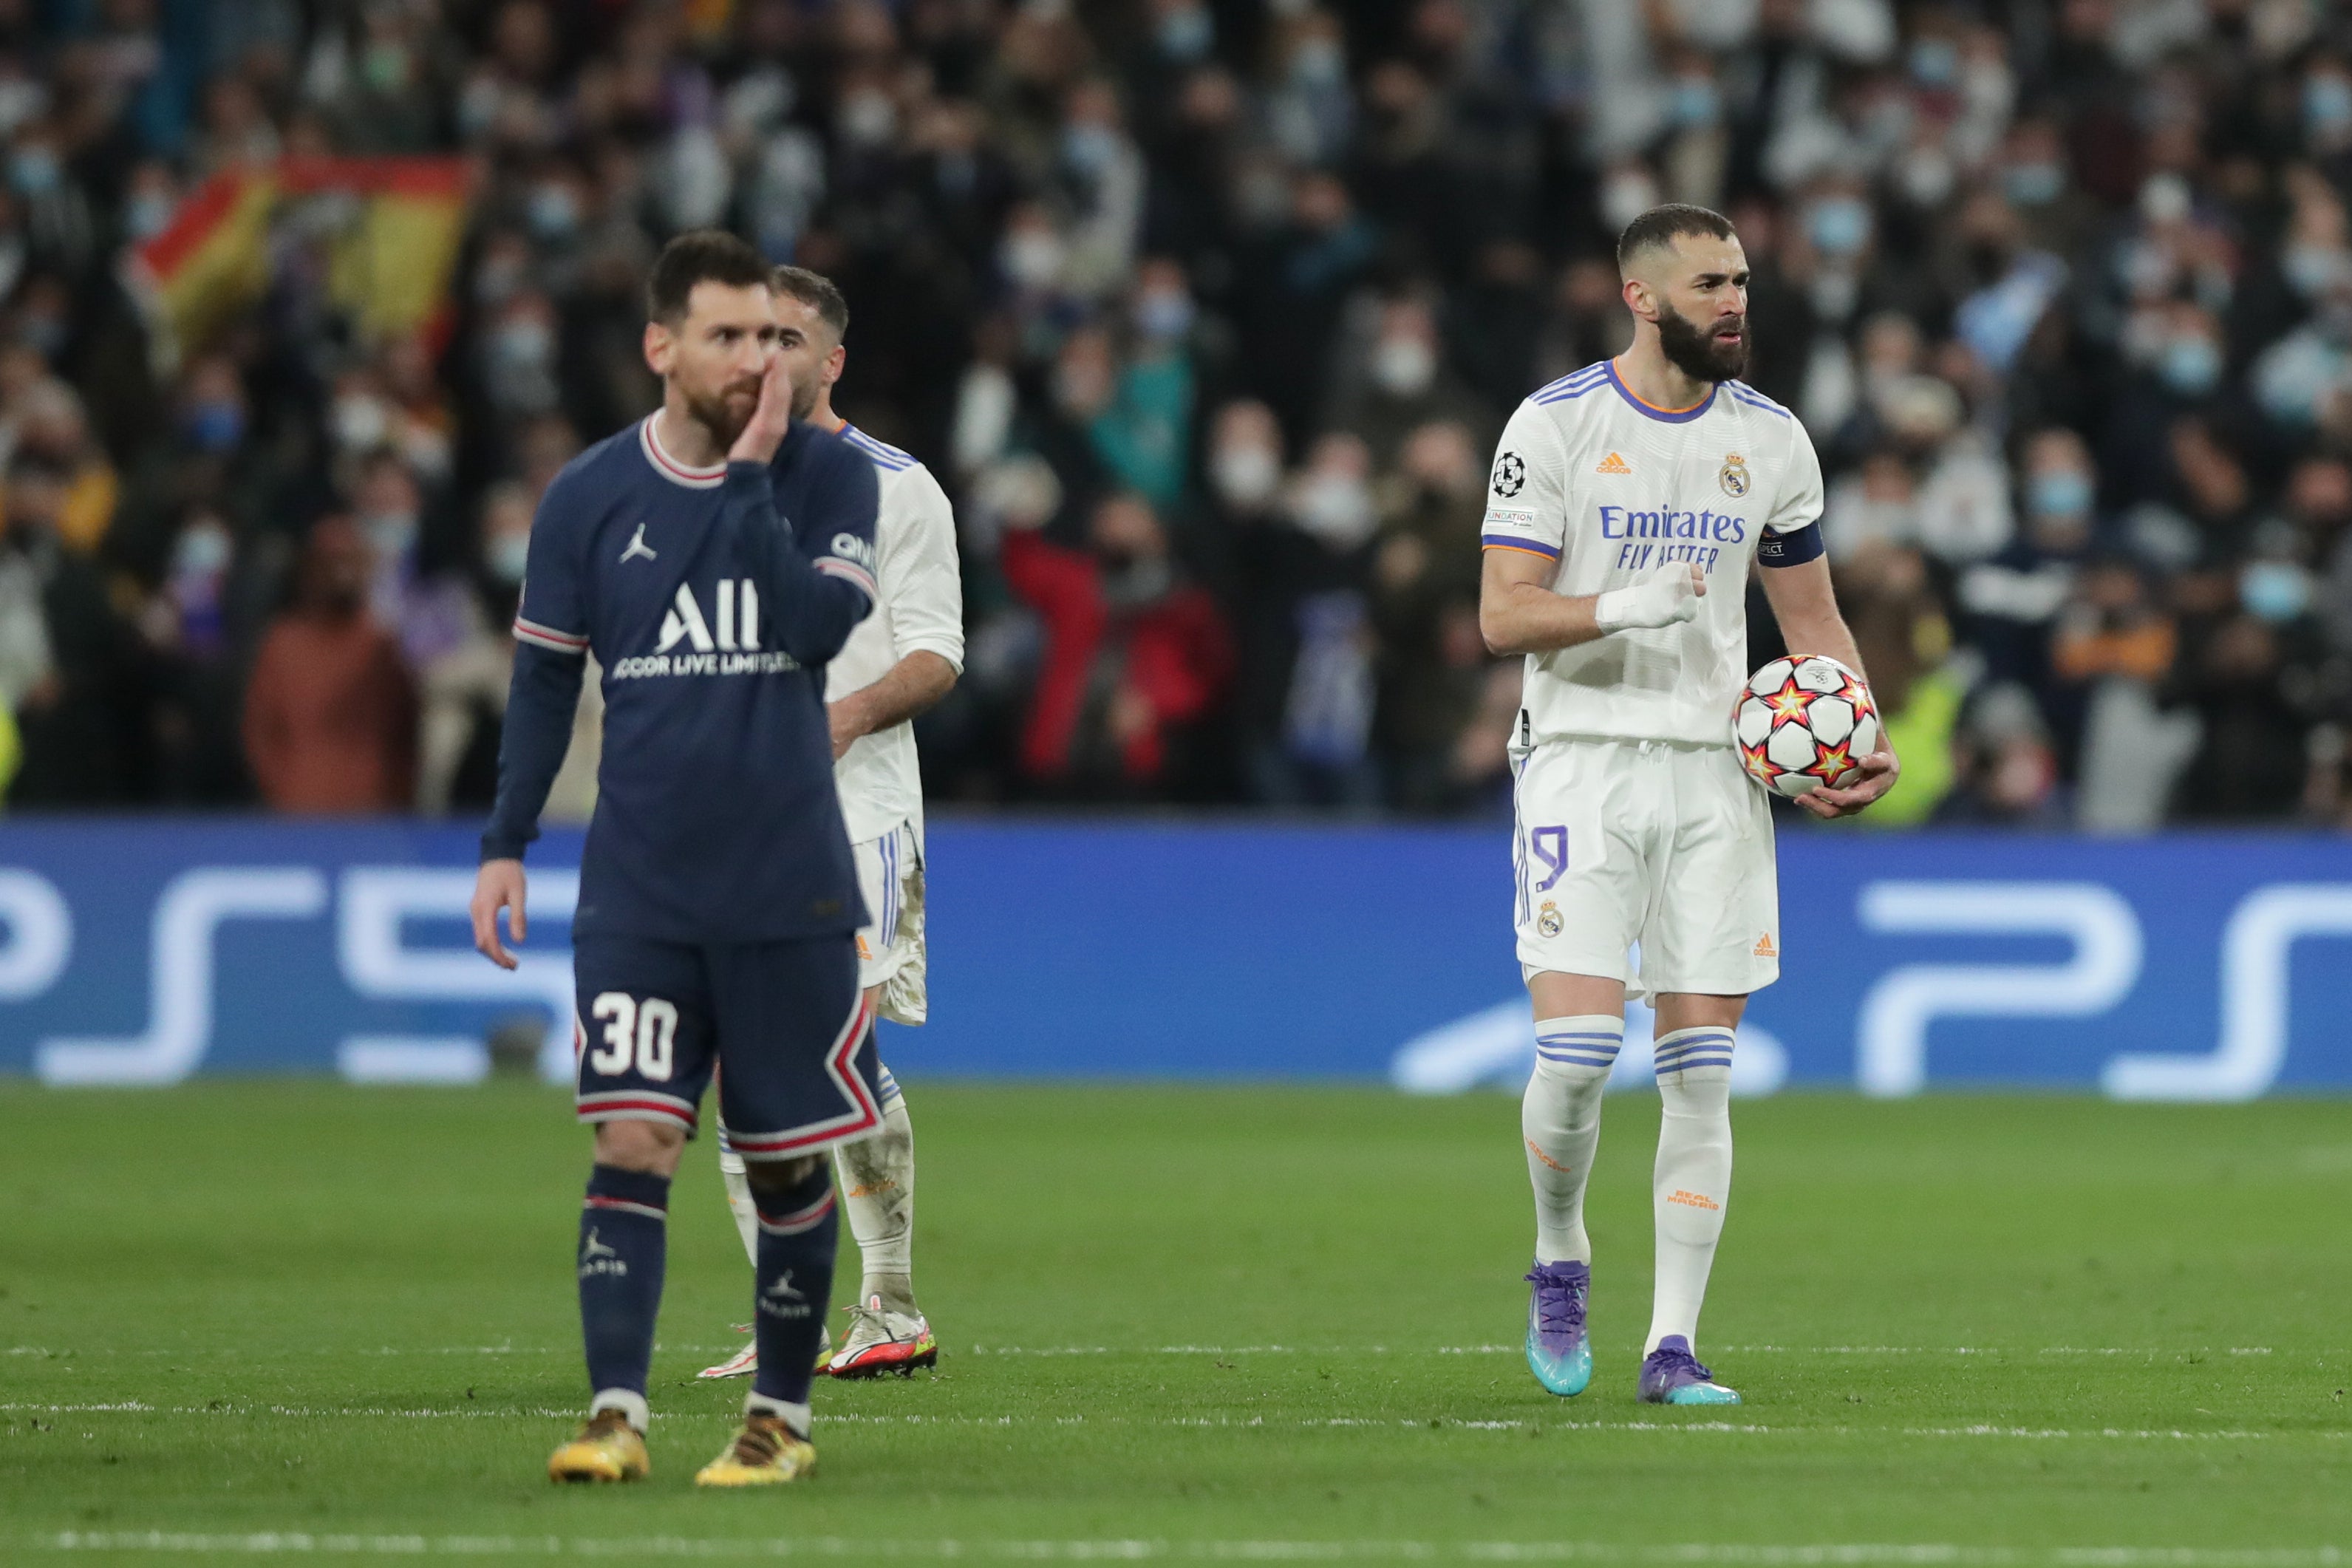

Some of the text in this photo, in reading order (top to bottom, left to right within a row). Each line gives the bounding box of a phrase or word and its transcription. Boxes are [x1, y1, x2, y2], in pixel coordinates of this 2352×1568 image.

[1496, 464, 1517, 485] 13
[1596, 465, 1632, 474] adidas
[1487, 511, 1533, 522] UNDATION
[1599, 505, 1745, 544] Emirates
[1617, 543, 1654, 570] FLY
[1759, 545, 1782, 554] SPECT
[672, 653, 718, 677] LIVE
[1531, 825, 1569, 893] 9
[591, 991, 678, 1082] 30
[1667, 1195, 1719, 1210] MADRID
[1675, 1189, 1713, 1203] REAL
